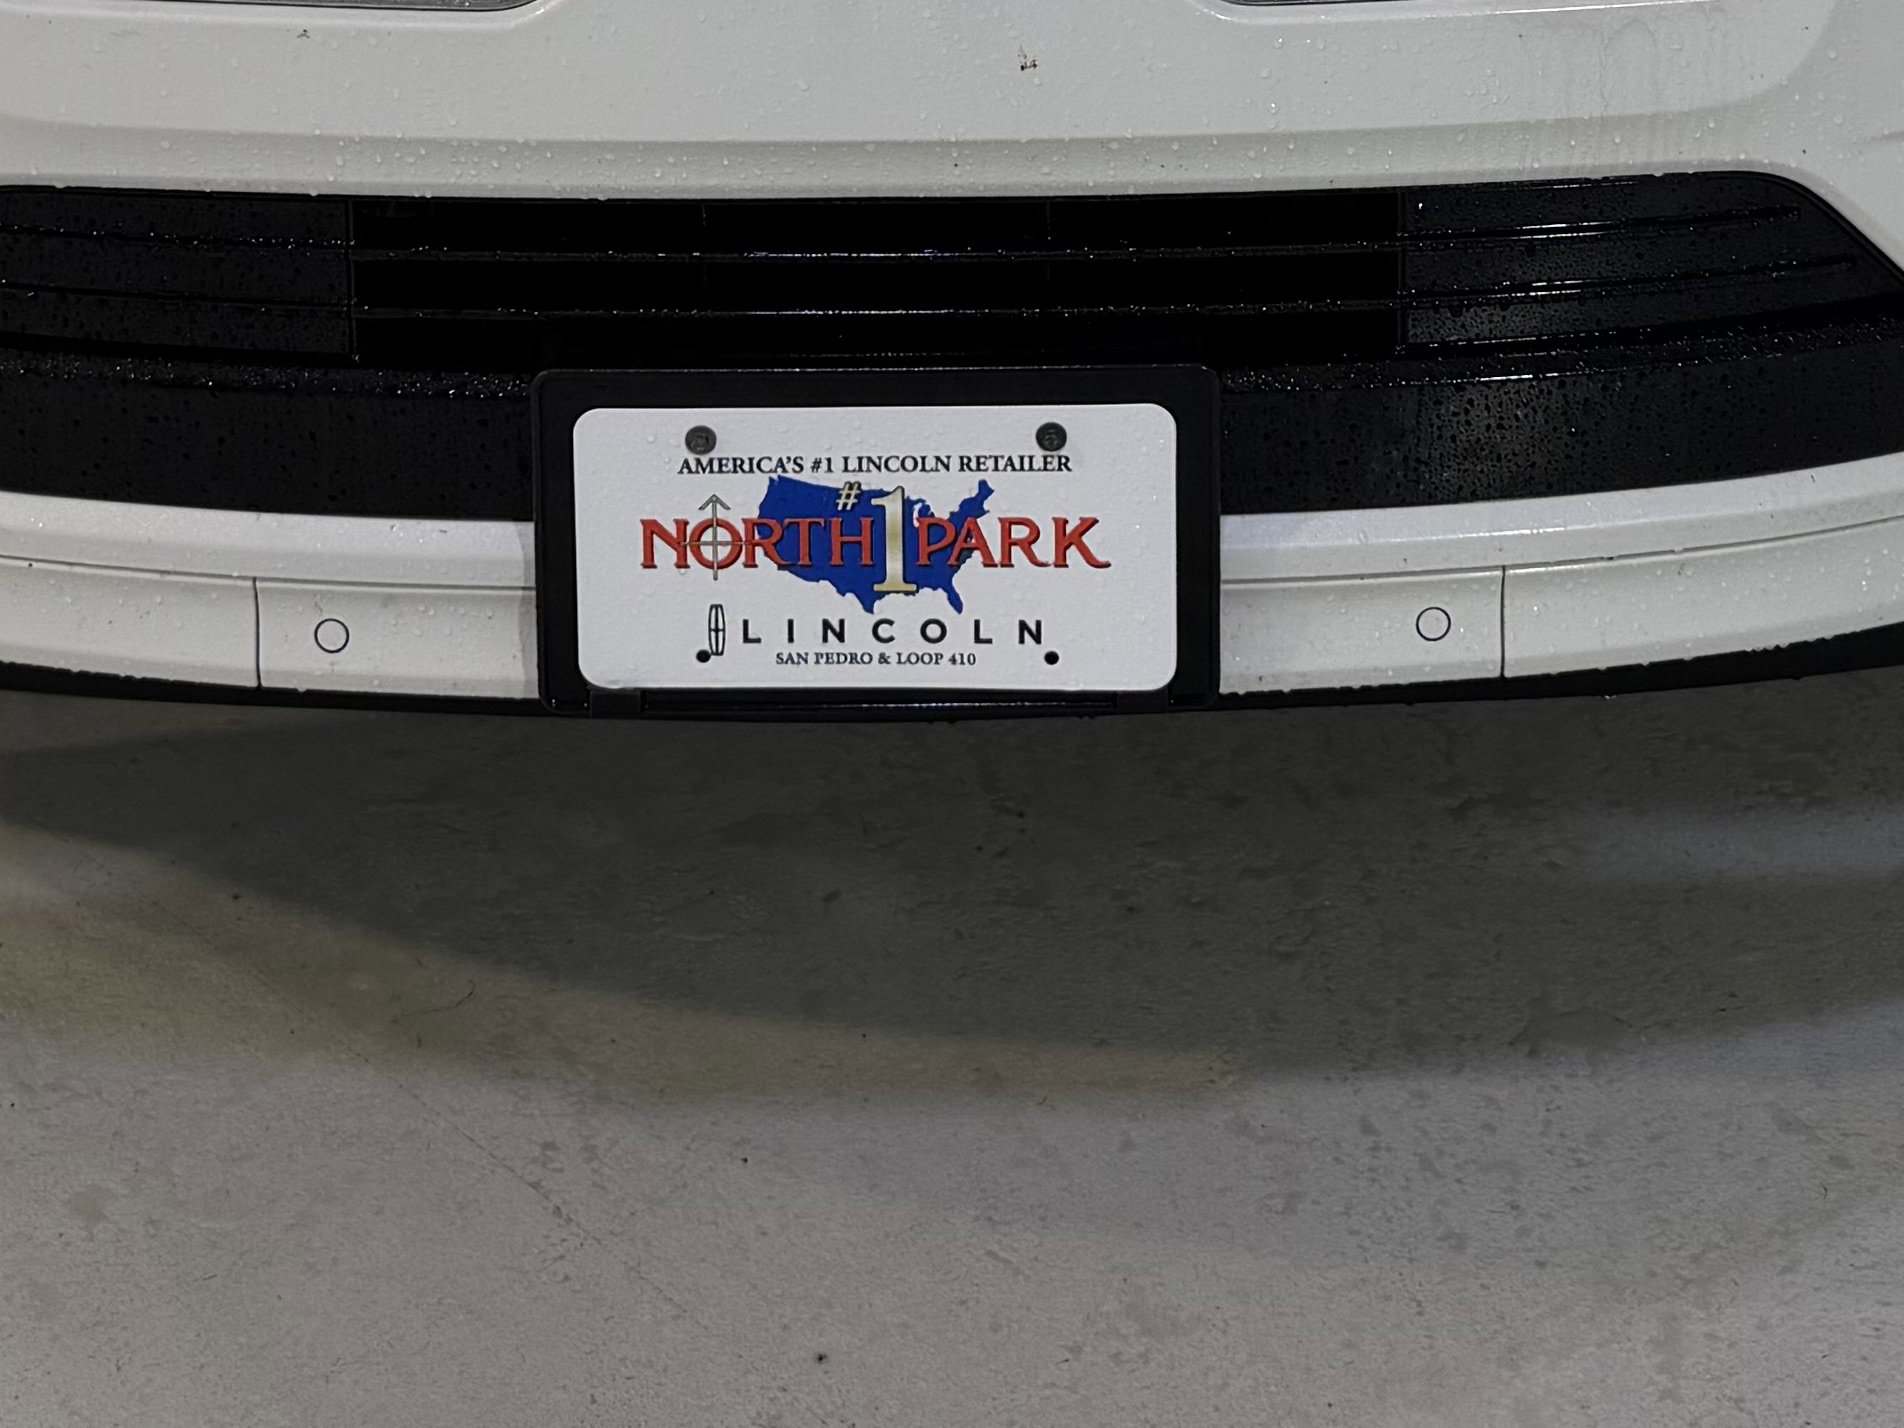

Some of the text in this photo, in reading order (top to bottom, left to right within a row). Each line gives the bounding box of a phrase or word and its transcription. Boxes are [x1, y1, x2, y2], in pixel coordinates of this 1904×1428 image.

[677, 455, 1072, 475] AMERICA'S #1 LINCOLN RETAILER
[640, 516, 1111, 569] NORTH PARK
[742, 618, 1043, 645] LINCOLN
[776, 652, 976, 666] SAN PEDRO & LOOP 410
